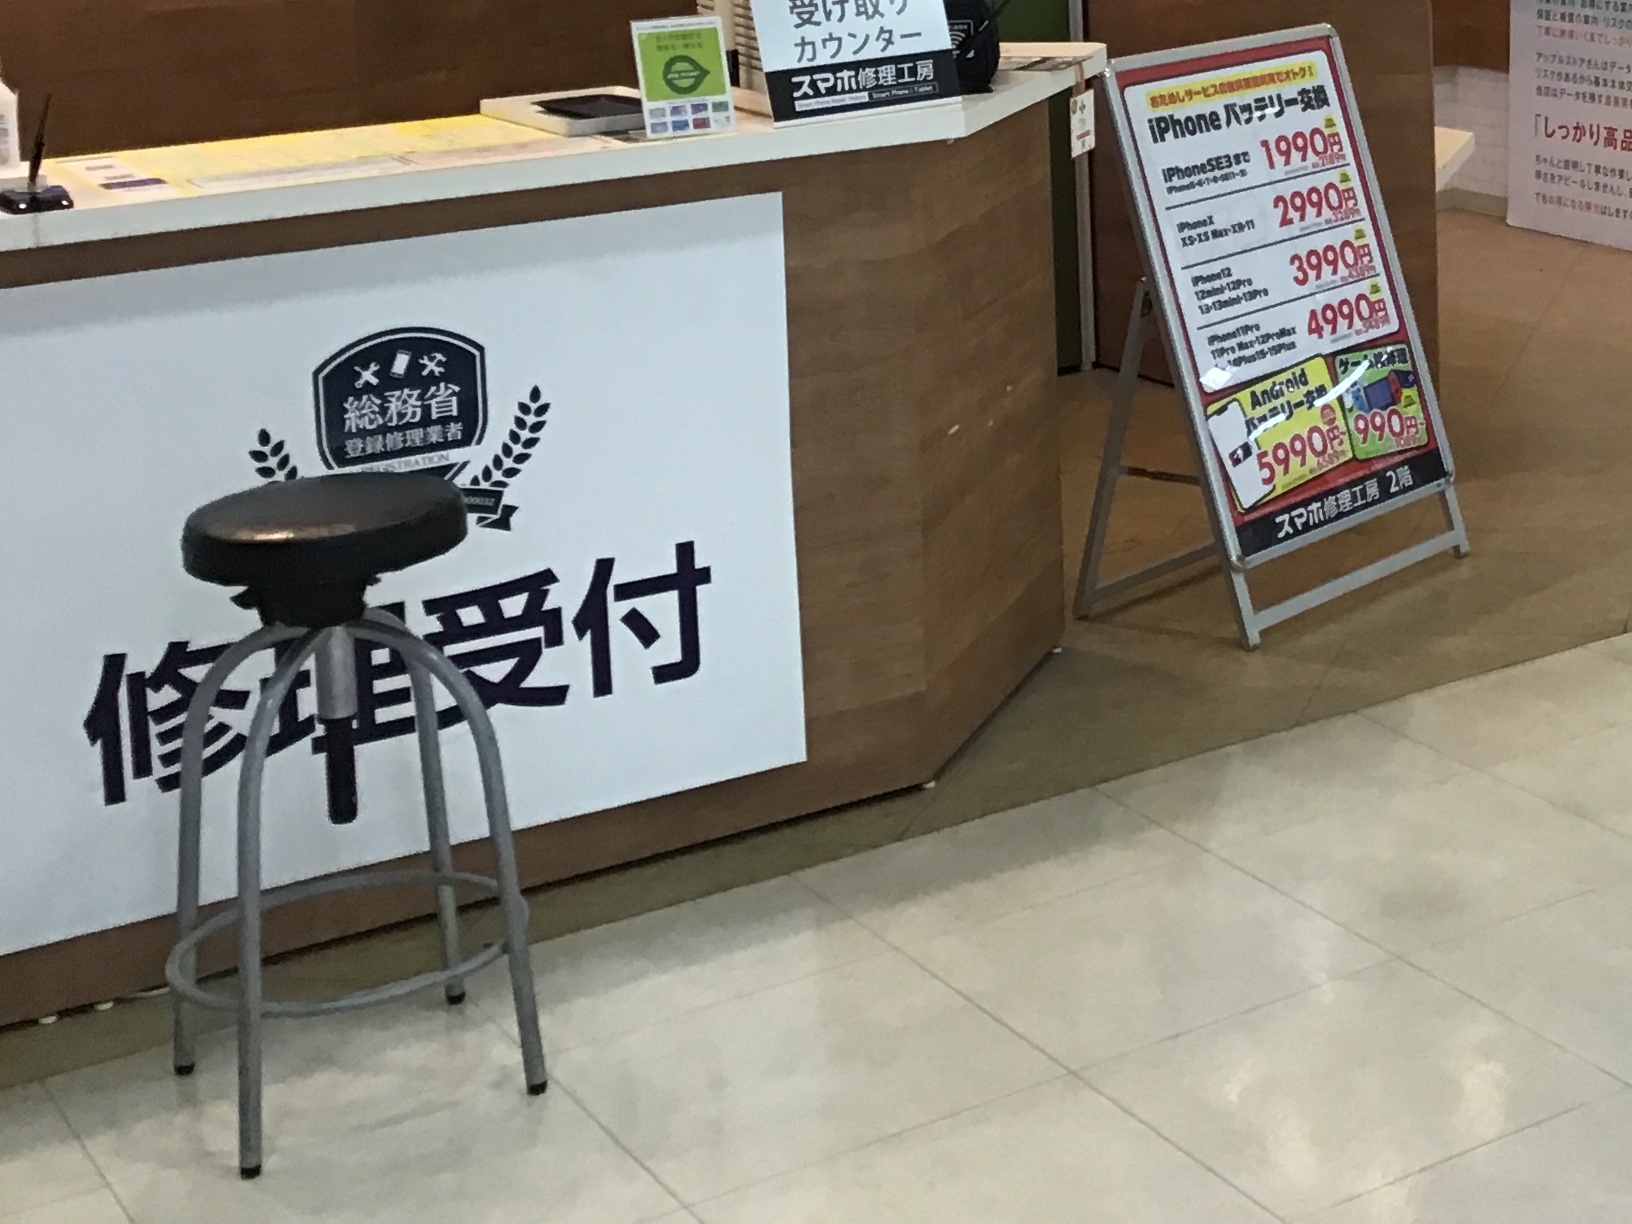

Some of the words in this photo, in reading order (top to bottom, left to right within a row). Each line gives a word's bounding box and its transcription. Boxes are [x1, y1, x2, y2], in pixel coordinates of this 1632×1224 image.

[794, 26, 922, 64] カウンター
[791, 59, 934, 99] スマホ修理工房
[1147, 110, 1222, 144] iPhone
[1224, 84, 1330, 127] バッテリー交換
[1260, 126, 1344, 170] 1990円
[1176, 215, 1215, 233] iPhoneX
[1273, 182, 1357, 228] 2990円
[1191, 267, 1232, 287] iPhone12
[1290, 240, 1373, 286] 3990円
[1308, 293, 1388, 339] 4990円
[343, 382, 461, 433] 総務省
[1249, 368, 1309, 410] Android
[344, 422, 463, 459] 登録修理業者
[1275, 477, 1380, 539] スマホ修理工房
[1386, 465, 1414, 494] 2階
